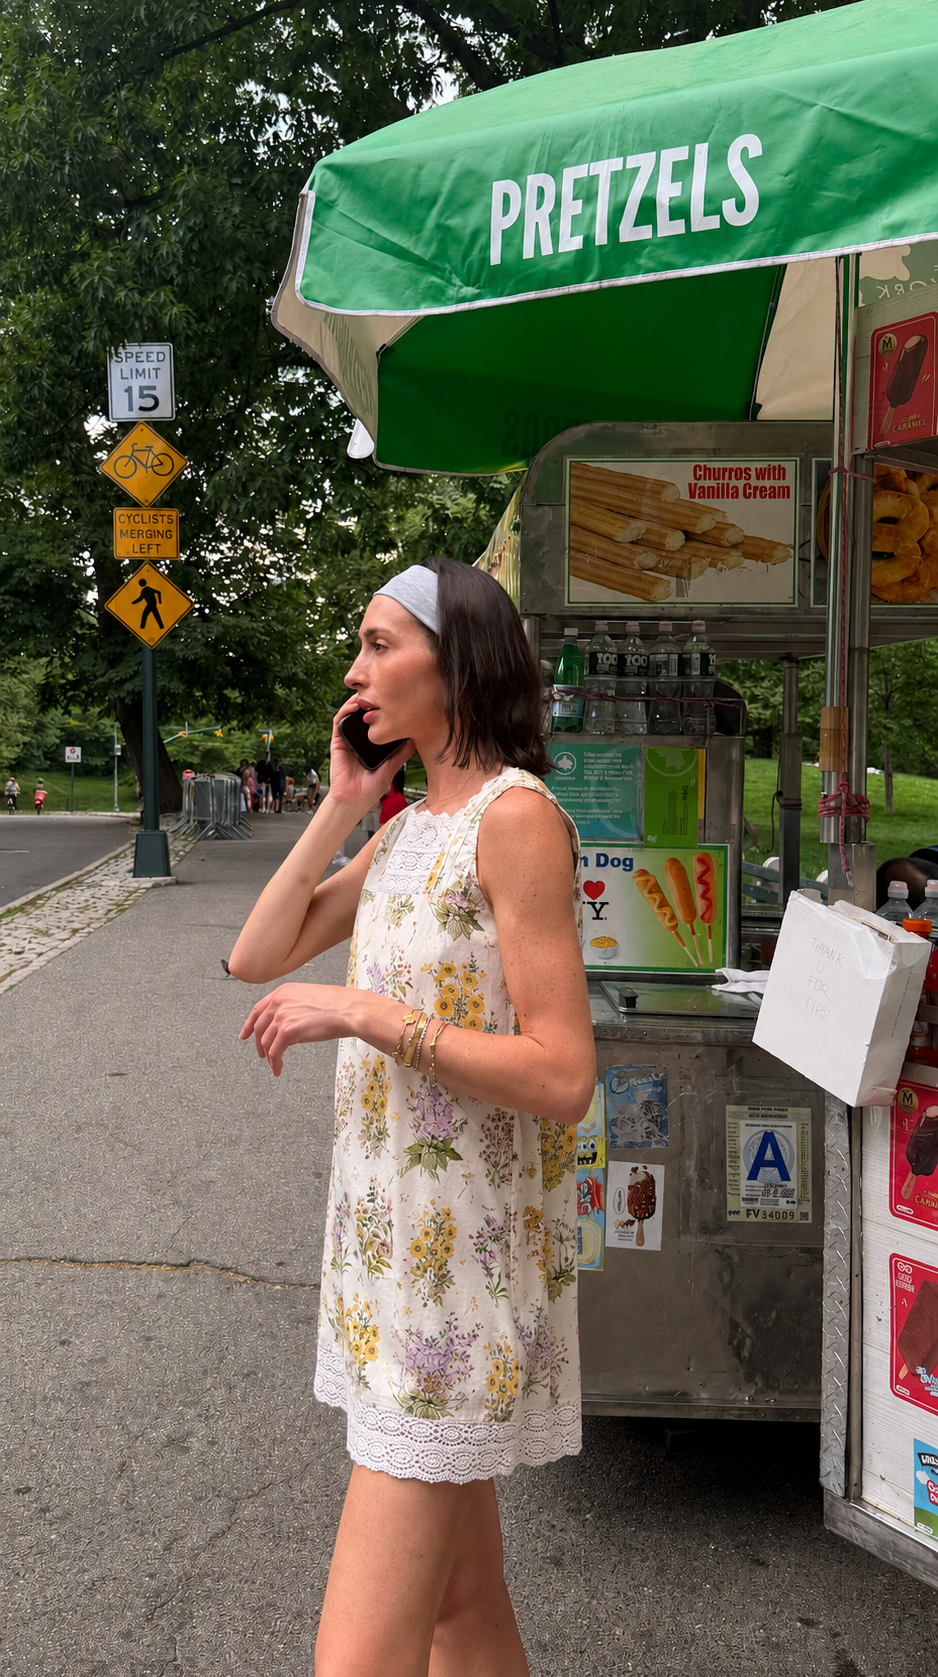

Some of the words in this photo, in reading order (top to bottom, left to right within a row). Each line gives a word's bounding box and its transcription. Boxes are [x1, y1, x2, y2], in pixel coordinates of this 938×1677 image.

[489, 133, 763, 266] PRETZELS
[114, 351, 166, 363] SPEED
[120, 367, 161, 380] LIMIT
[123, 385, 160, 412] 15
[692, 464, 752, 481] Churros
[754, 464, 787, 481] with
[687, 482, 740, 499] Vanilla
[742, 482, 791, 499] Cream
[118, 514, 174, 525] CYCLISTS
[119, 529, 173, 540] MERGING
[132, 544, 161, 555] LEFT
[595, 852, 634, 873] Dog
[816, 961, 825, 975] U
[804, 994, 831, 1022] TIPS
[746, 1131, 792, 1182] A
